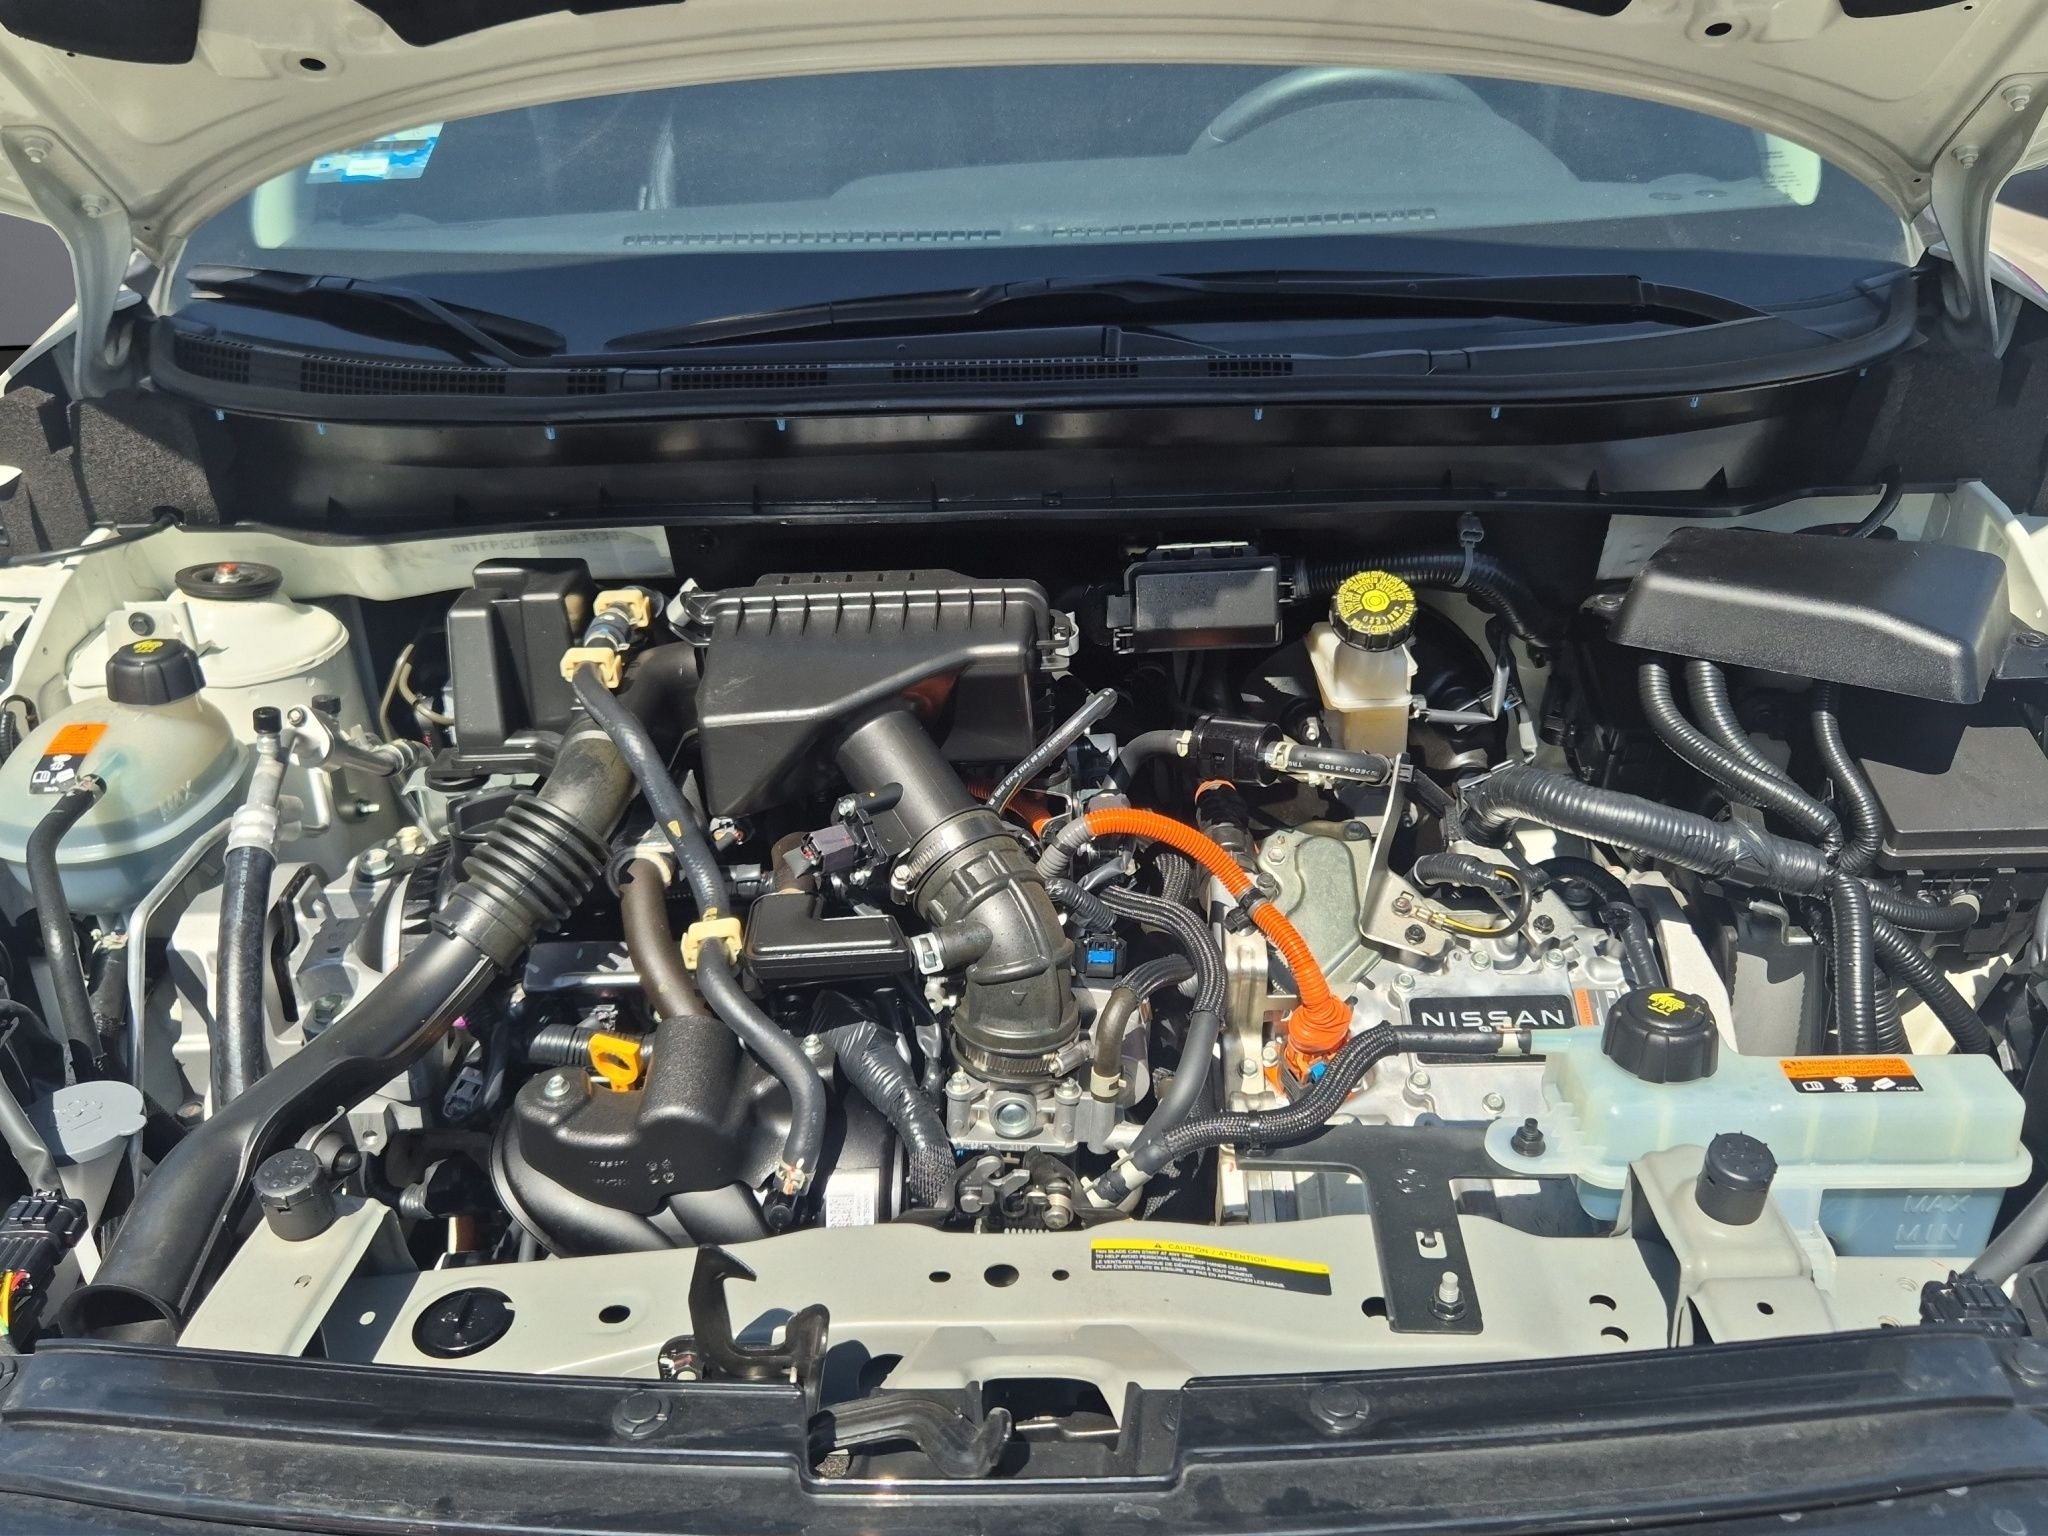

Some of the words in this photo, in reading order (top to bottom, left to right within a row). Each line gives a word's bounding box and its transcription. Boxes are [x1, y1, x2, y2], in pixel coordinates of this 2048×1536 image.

[1421, 1010, 1565, 1028] NISSAN
[1903, 1194, 1971, 1213] MAX
[1896, 1223, 1964, 1241] MIN
[1168, 1244, 1208, 1254] CAUTION
[1218, 1250, 1267, 1263] ATTENTION
